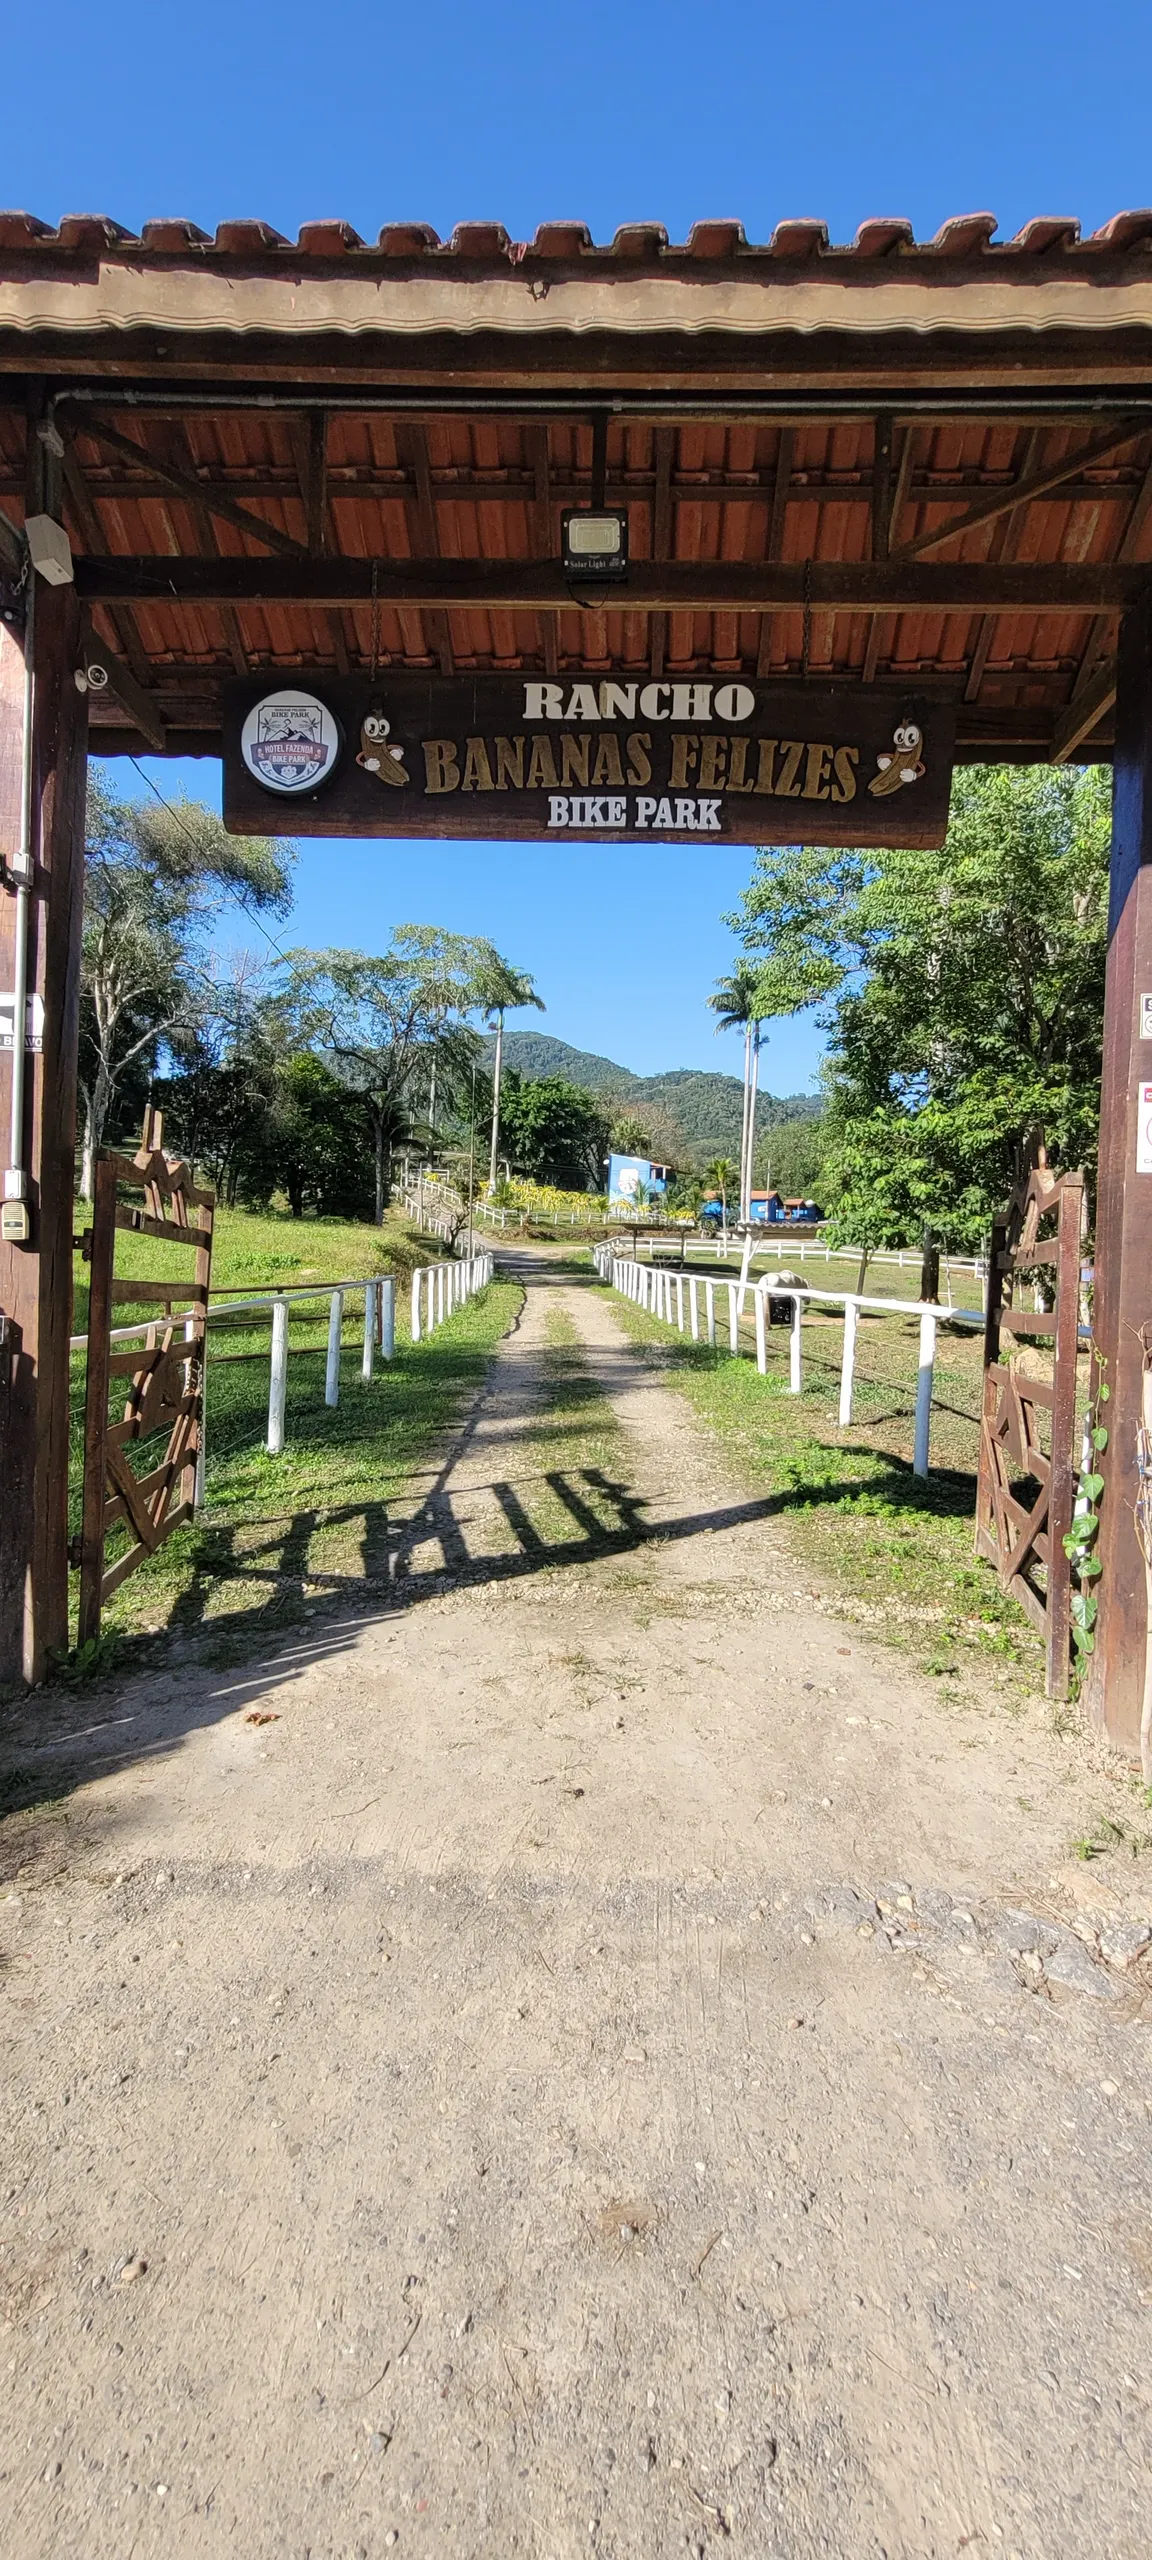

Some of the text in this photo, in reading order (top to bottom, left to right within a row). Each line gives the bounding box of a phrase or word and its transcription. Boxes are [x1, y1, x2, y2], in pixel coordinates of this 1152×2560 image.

[570, 560, 587, 568] Solar
[588, 560, 606, 569] Light
[522, 682, 755, 721] RANCHO
[265, 744, 313, 754] HOTEL FAZENDA
[421, 733, 860, 802] BANANAS FELIZES
[547, 796, 722, 830] BIKE PARK
[4, 1036, 42, 1047] BVO
